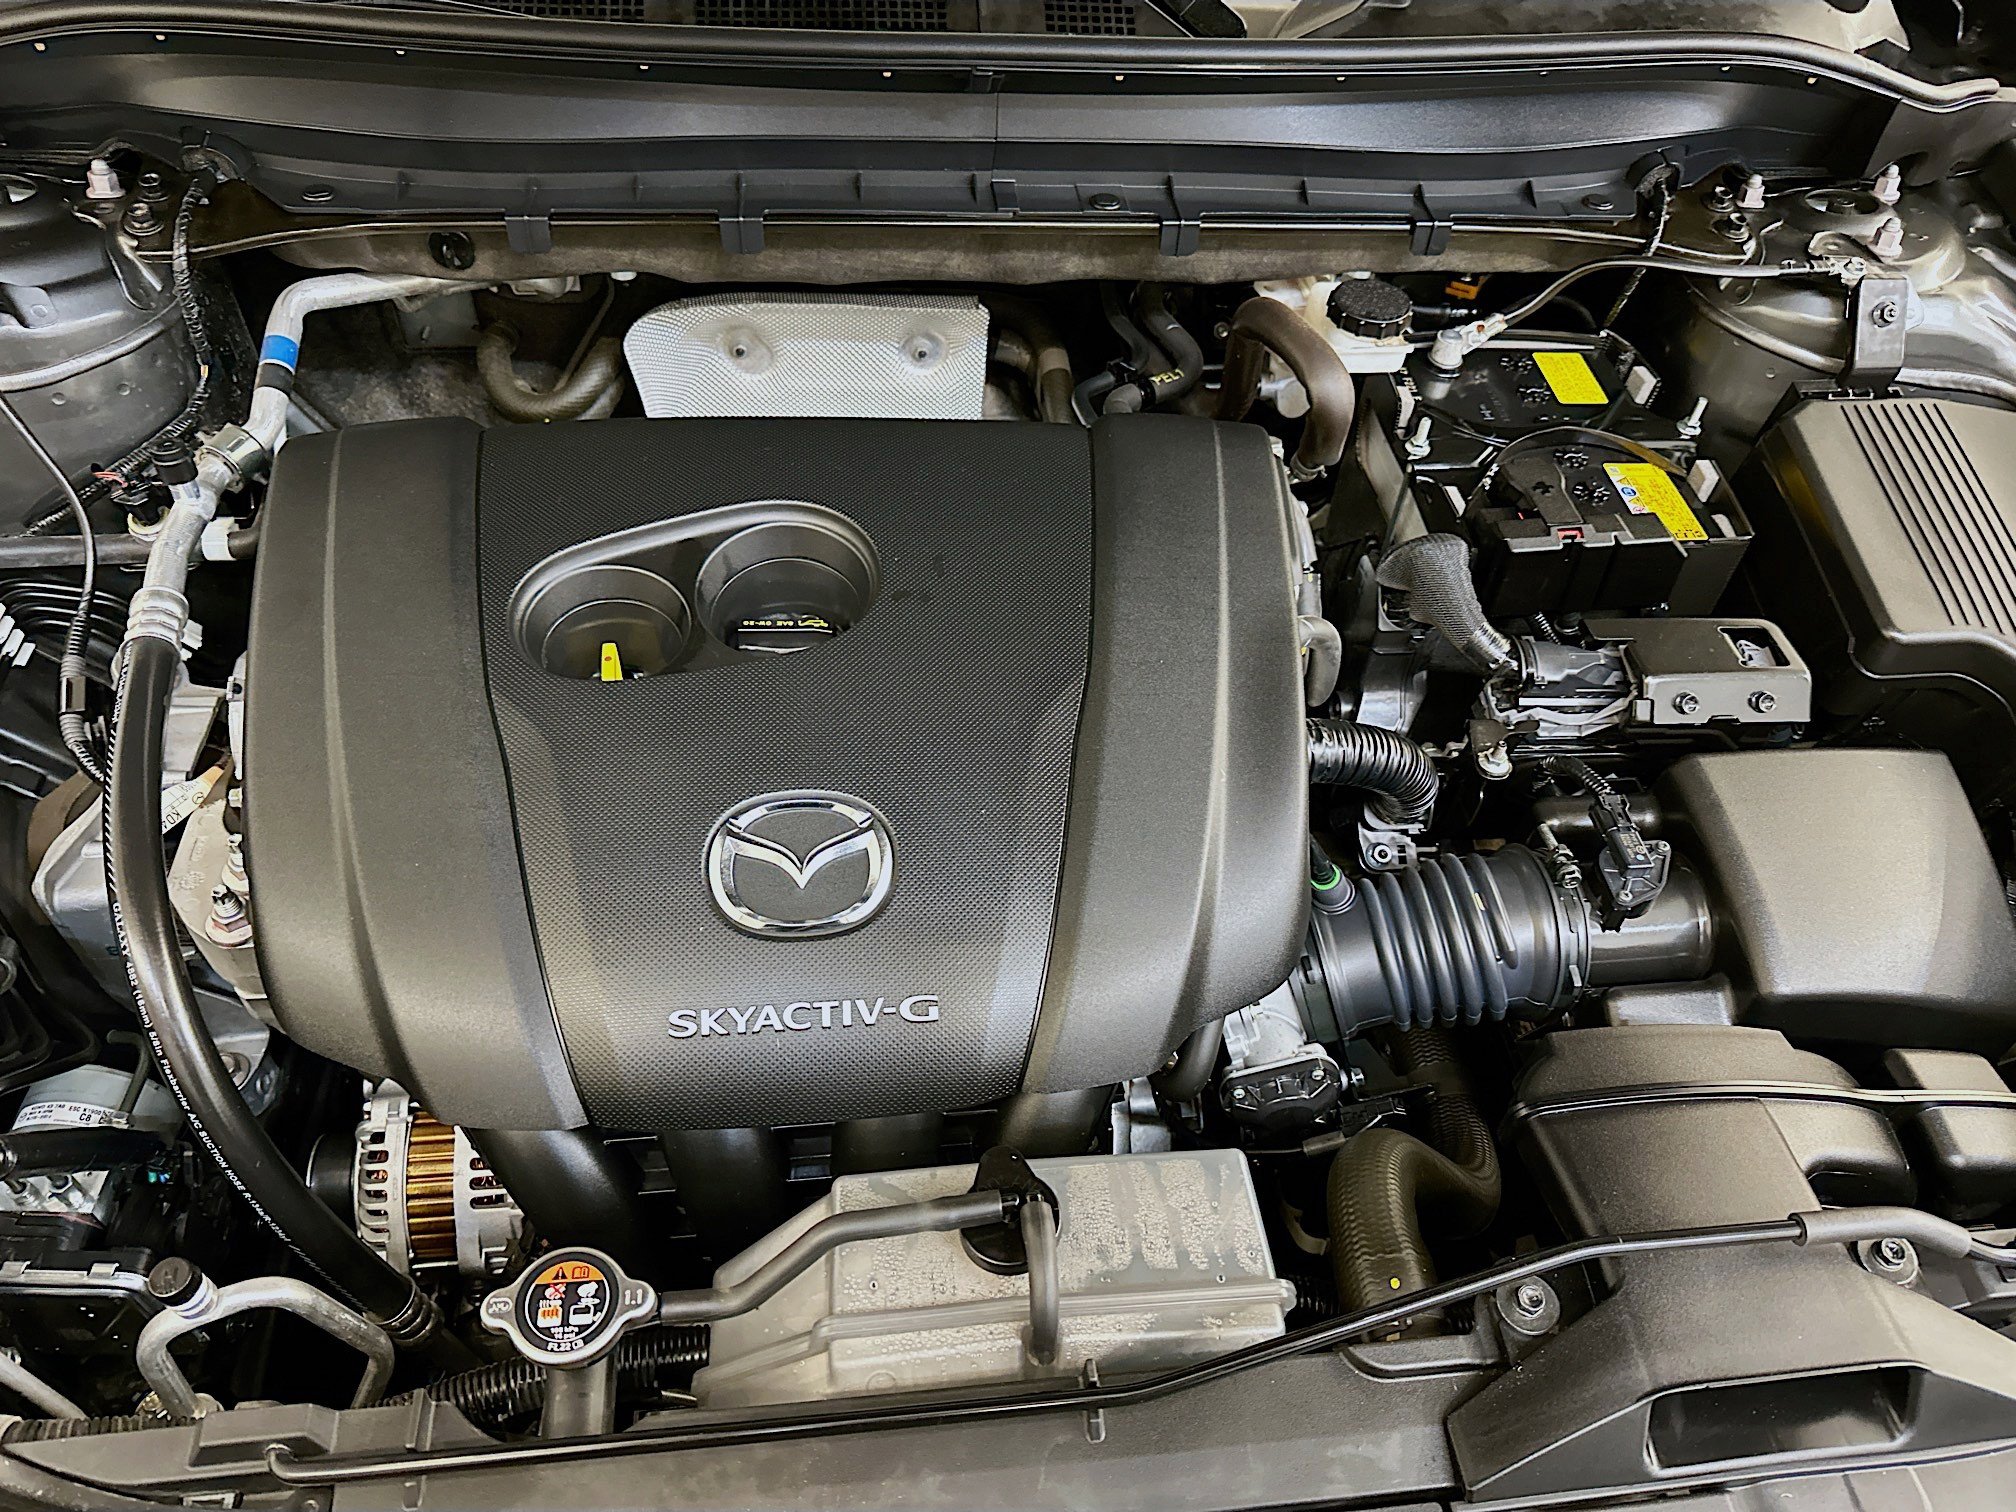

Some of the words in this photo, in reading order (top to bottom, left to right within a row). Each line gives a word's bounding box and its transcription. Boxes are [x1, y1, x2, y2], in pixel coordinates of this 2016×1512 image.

[776, 620, 795, 628] SAE
[668, 994, 939, 1038] SKYACTIV-G
[112, 902, 132, 958] GALAXY
[125, 961, 139, 987] 4882
[132, 989, 154, 1029] (16mm)
[160, 1058, 191, 1111] Flexbarrier
[187, 1112, 203, 1130] A/C
[198, 1130, 229, 1168] SUCTION
[225, 1169, 247, 1191] HOSE
[624, 1289, 643, 1306] 1.1
